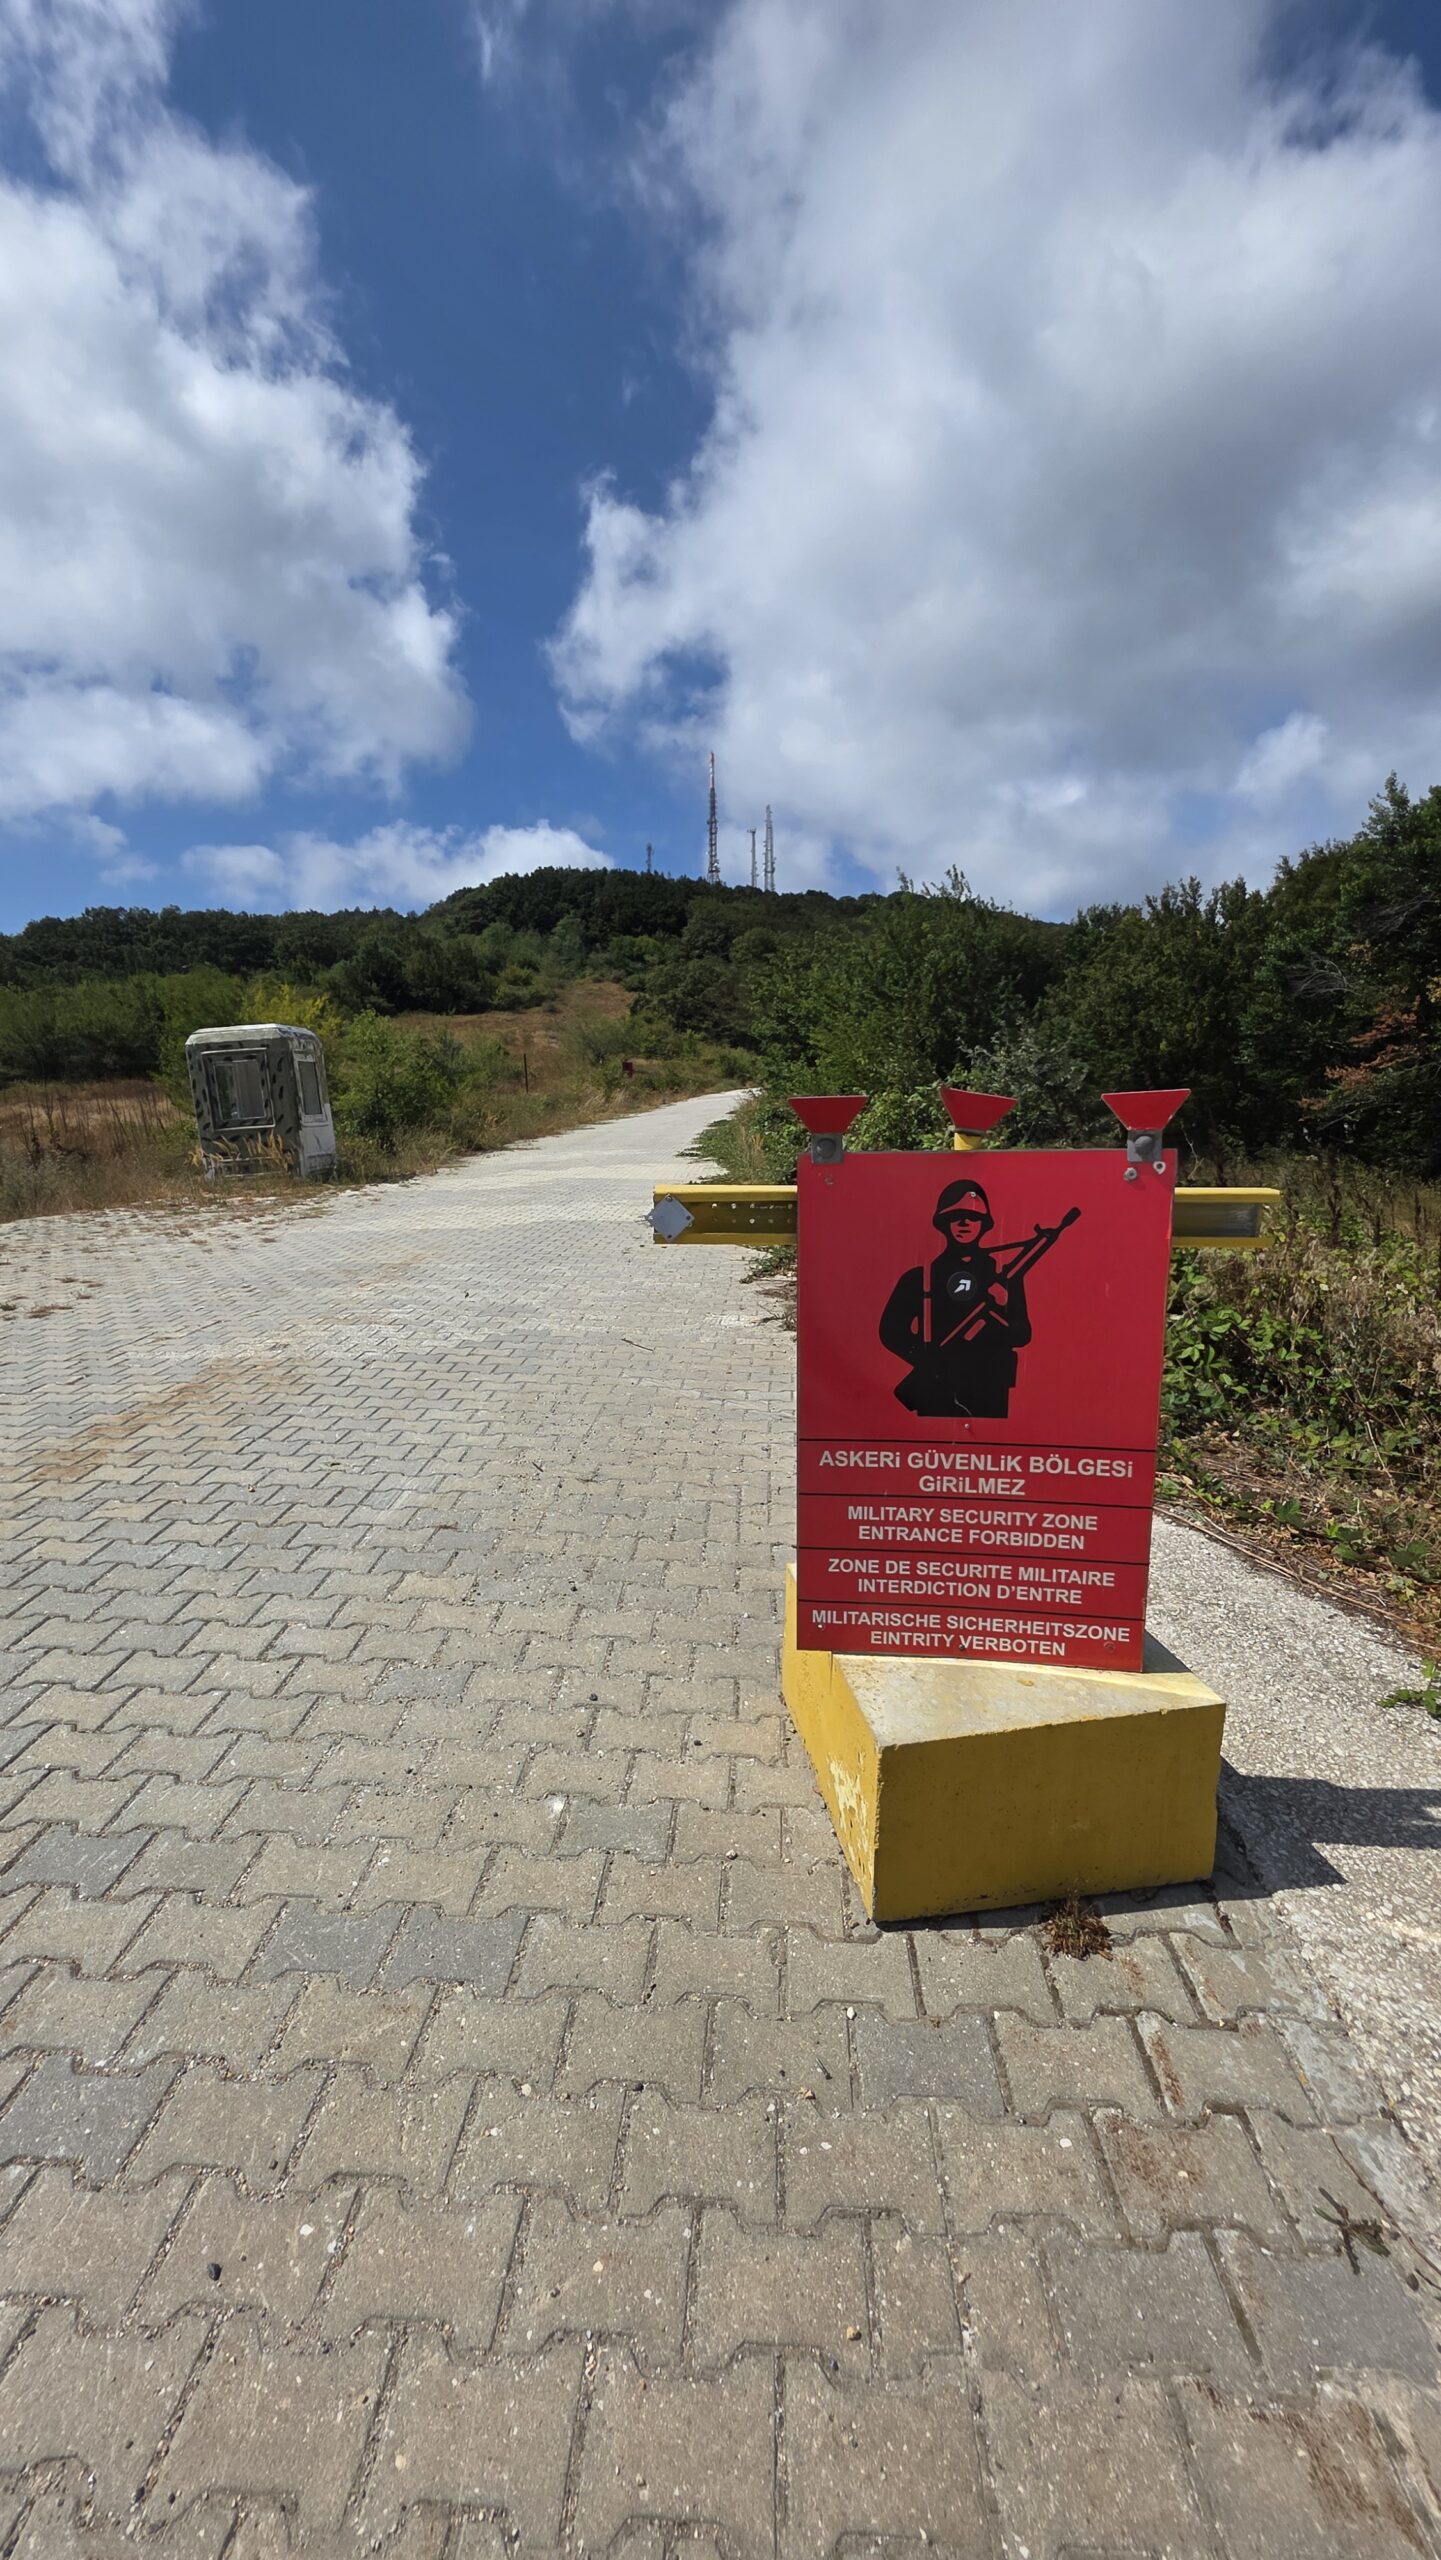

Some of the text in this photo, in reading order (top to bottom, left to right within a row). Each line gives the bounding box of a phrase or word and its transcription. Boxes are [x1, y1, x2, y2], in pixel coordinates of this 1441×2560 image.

[848, 1505, 1098, 1531] MILITARY SECURITY ZONE
[858, 1525, 1085, 1550] ENTRANCE FORBIDDEN
[828, 1558, 1116, 1587] ZONE DE SECURITE MILITAIRE
[858, 1578, 991, 1598] INTERDICTION
[812, 1609, 1131, 1643] MILITARISCHE SICHERHEITSZONE
[870, 1630, 1066, 1657] EINTRITY VERBOTEN
